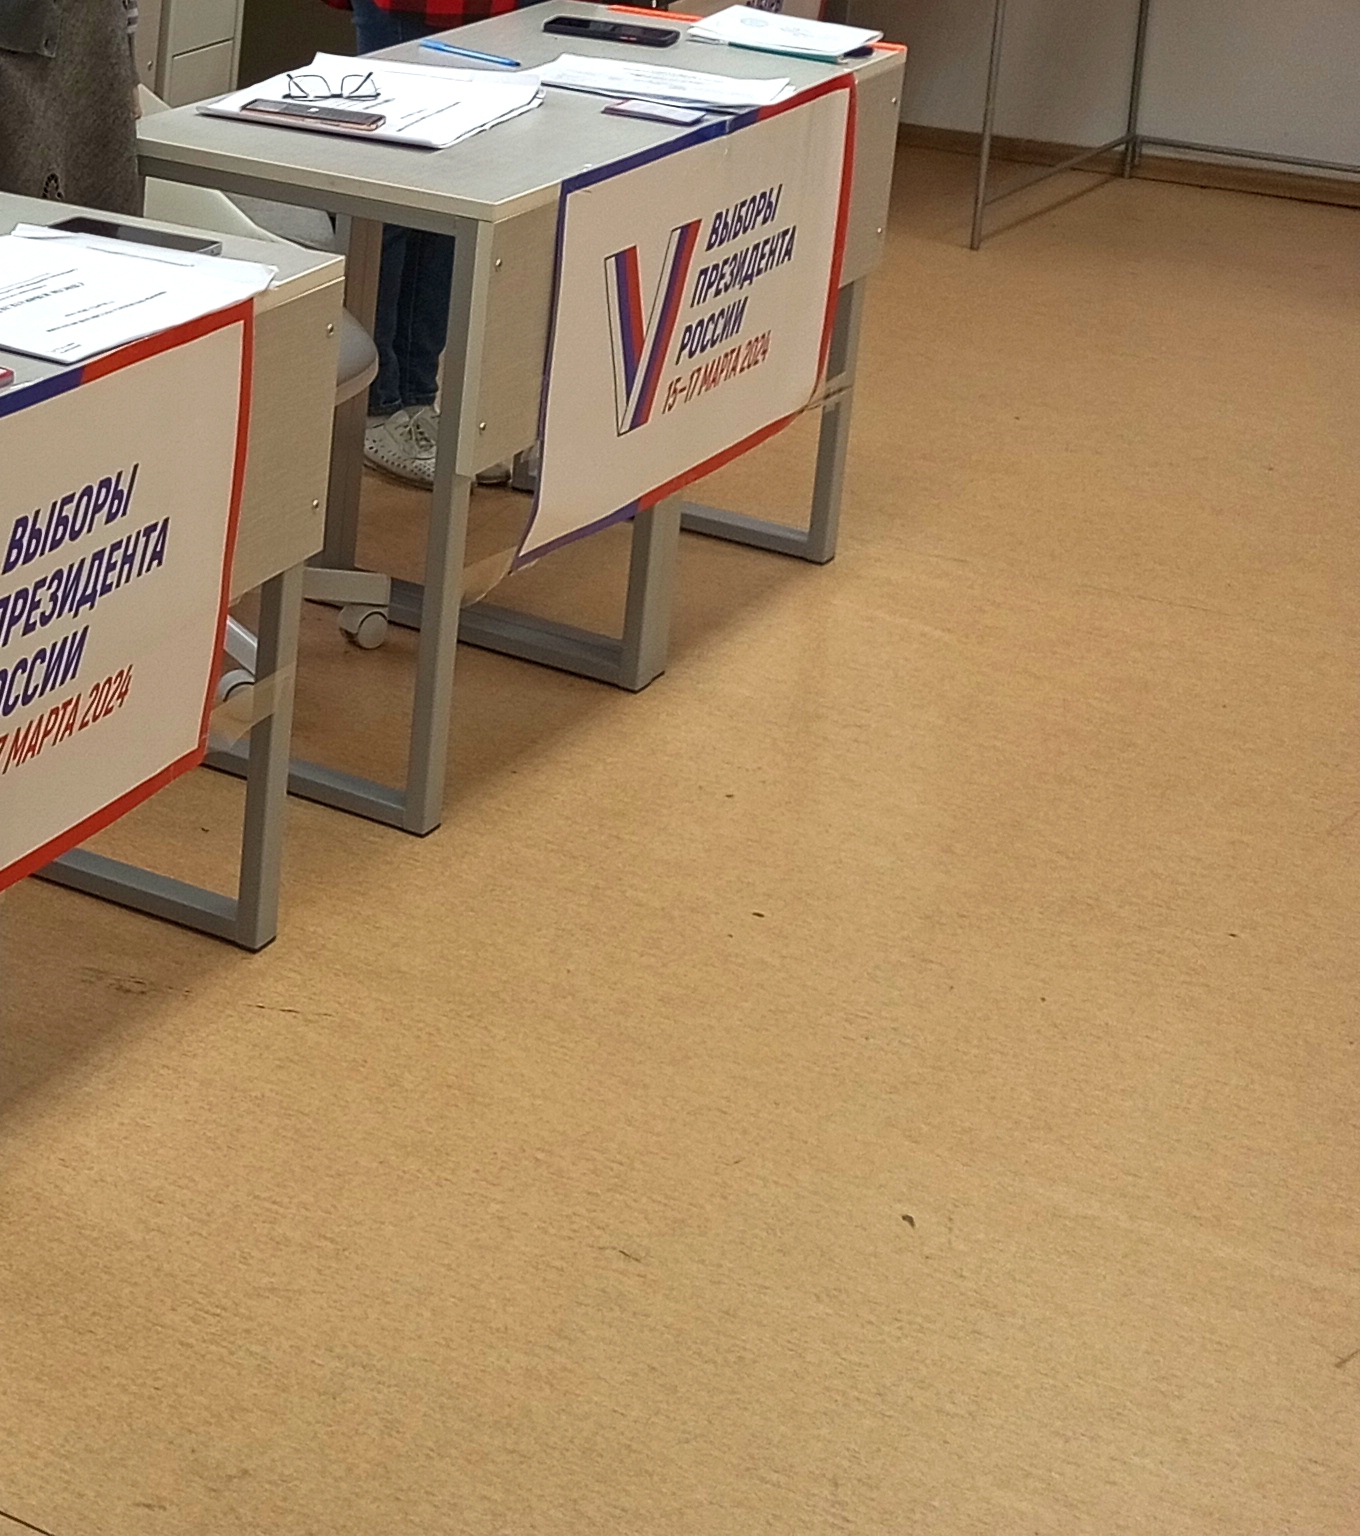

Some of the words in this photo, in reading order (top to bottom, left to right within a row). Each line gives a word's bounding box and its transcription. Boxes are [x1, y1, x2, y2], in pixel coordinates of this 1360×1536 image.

[705, 184, 782, 251] ВЫБОРЫ
[690, 225, 796, 308] ПРЕЗИДЕНТА
[675, 296, 749, 365] РОССИИ
[698, 345, 741, 396] МАРТА
[739, 330, 771, 374] 2024
[1, 462, 139, 575] ВЫБОРЫ
[2, 693, 81, 775] МАРТА
[78, 664, 134, 731] 2024
